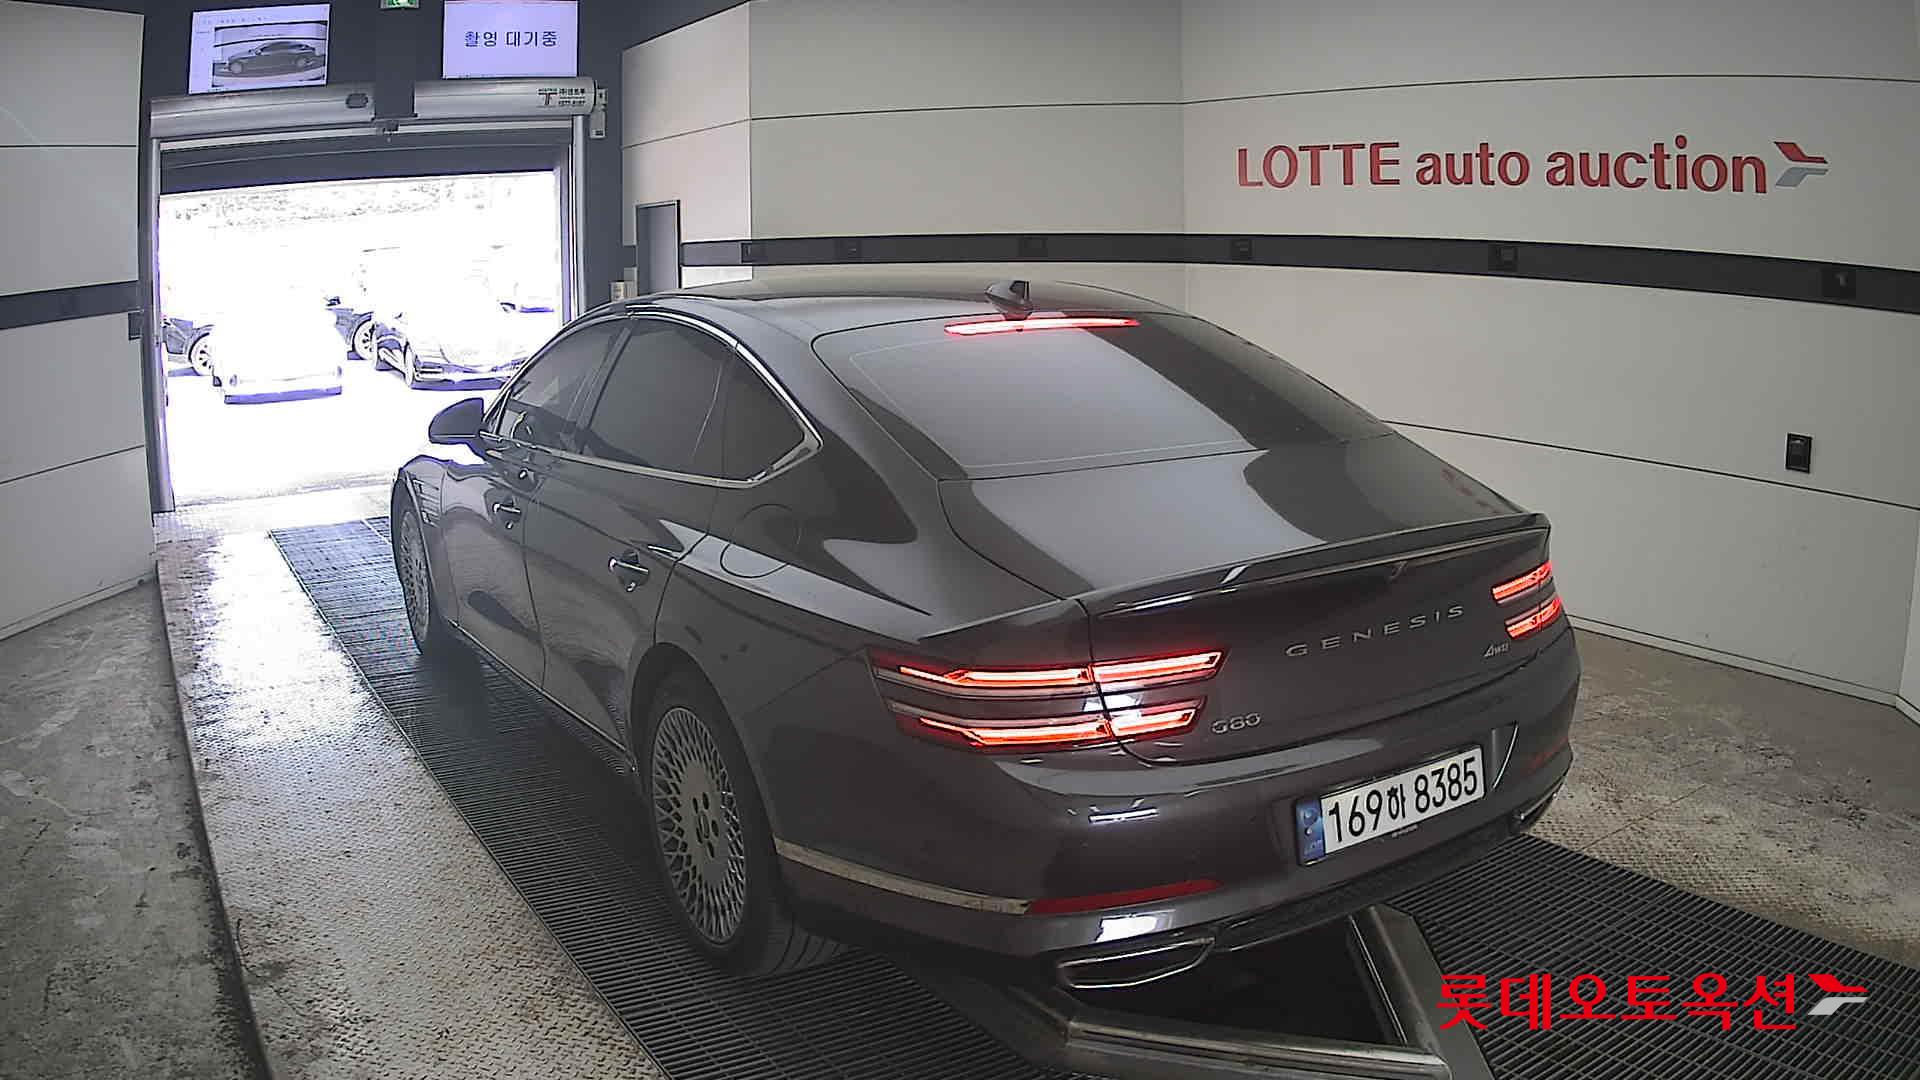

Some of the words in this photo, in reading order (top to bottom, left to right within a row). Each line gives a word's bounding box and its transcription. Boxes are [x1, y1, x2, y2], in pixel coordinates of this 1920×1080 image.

[465, 31, 497, 47] 촬영
[506, 31, 558, 47] 대기중
[1236, 142, 1400, 188] LOTTE
[1415, 142, 1530, 186] auto
[1545, 135, 1767, 194] auction
[1285, 605, 1464, 657] GENESIS
[1211, 712, 1260, 734] G80
[1328, 783, 1406, 843] 169하
[1414, 756, 1478, 814] 8385
